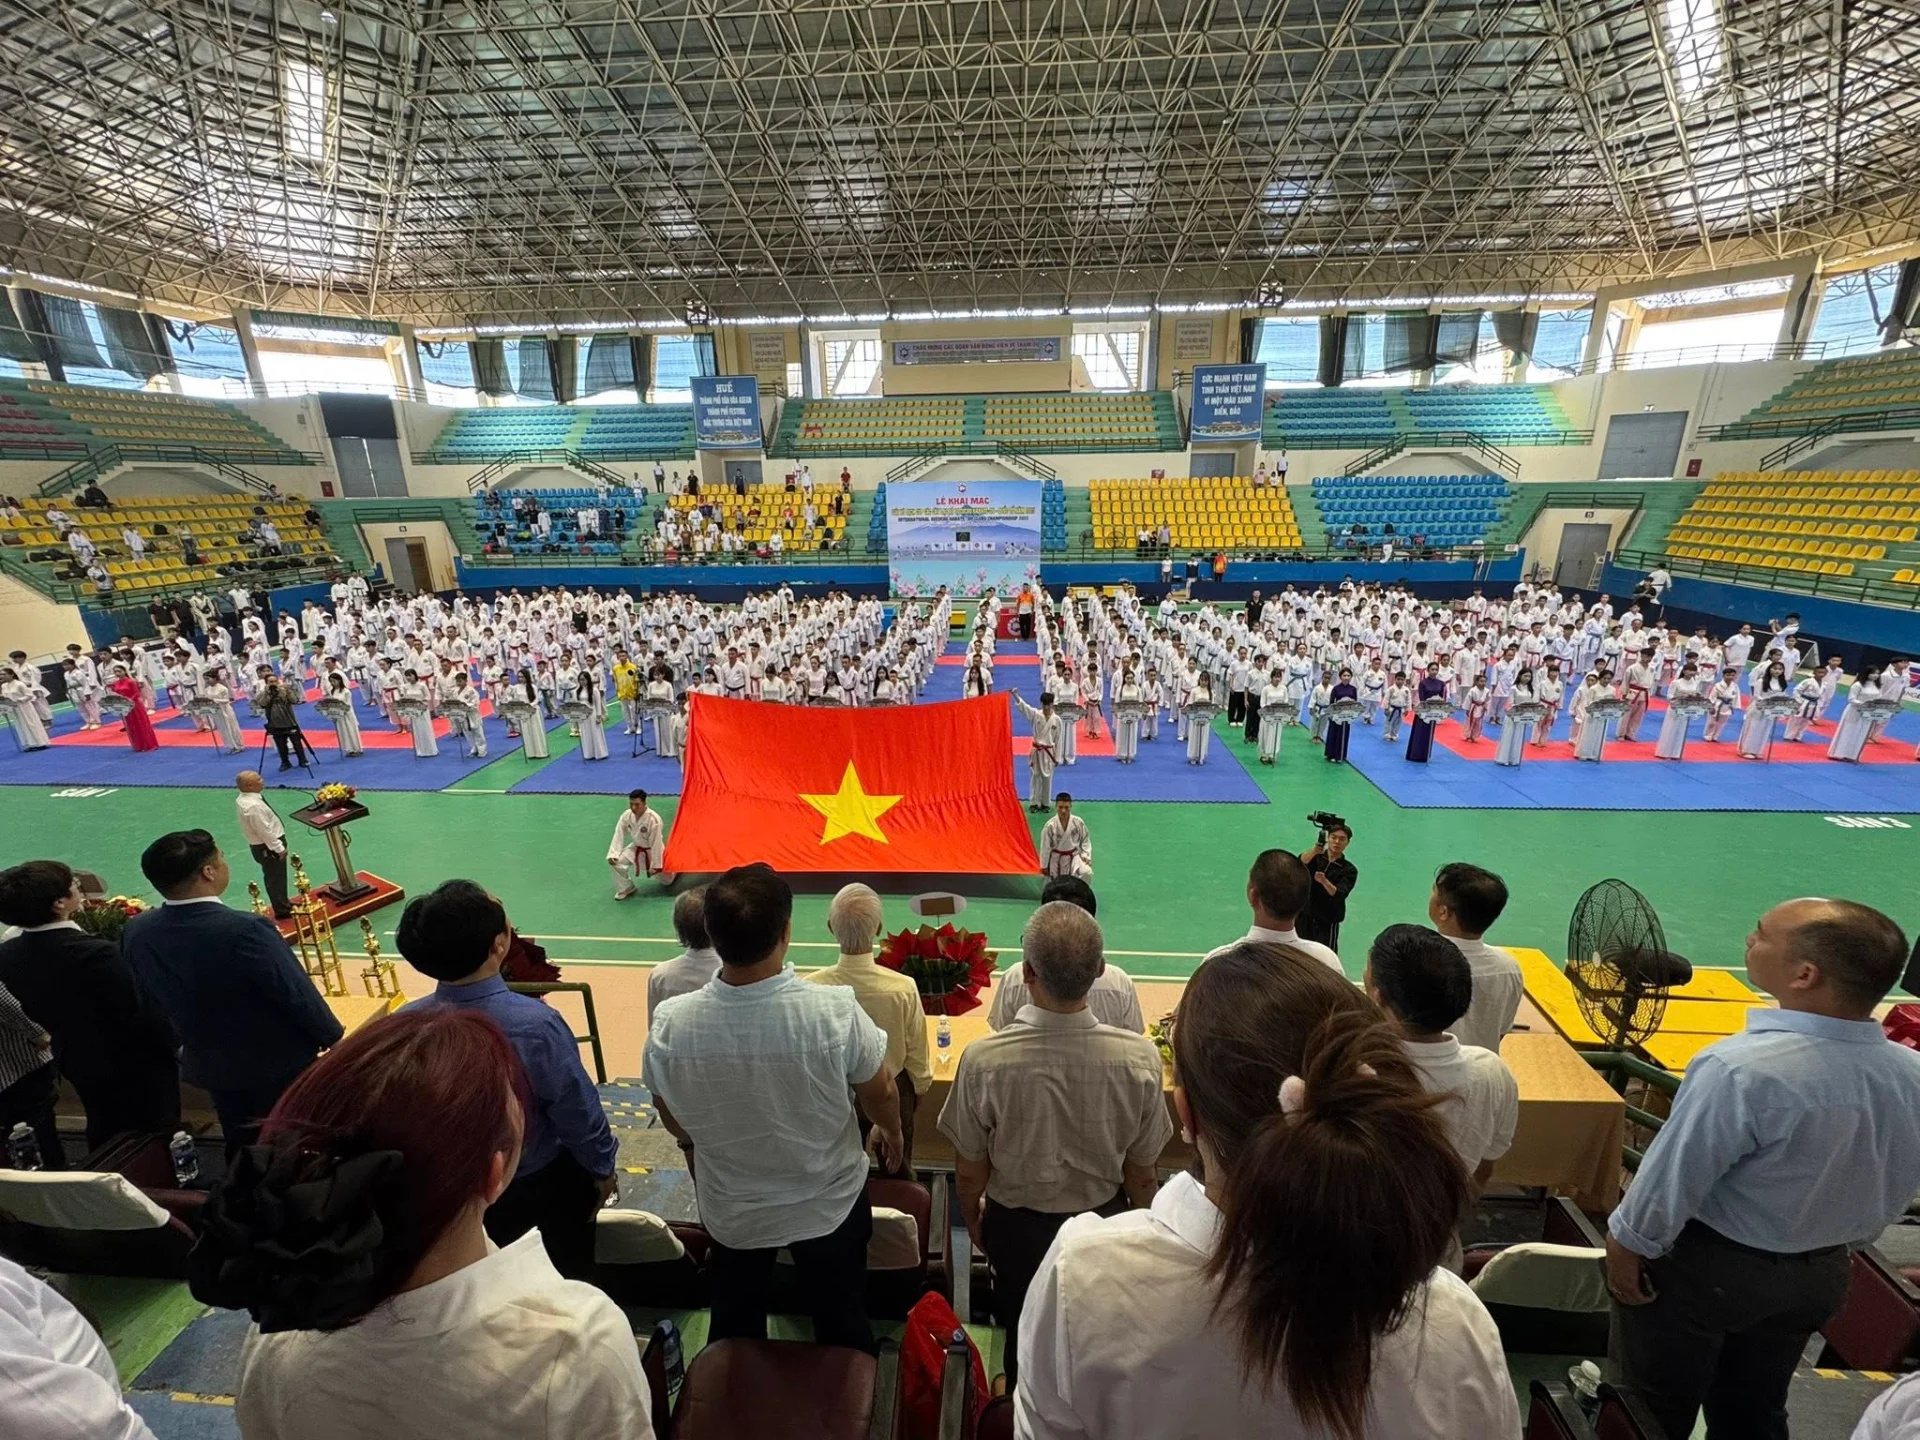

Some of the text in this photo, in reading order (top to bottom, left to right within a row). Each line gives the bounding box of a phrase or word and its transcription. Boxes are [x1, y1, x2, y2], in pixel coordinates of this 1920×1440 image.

[1232, 372, 1243, 384] VIỆT
[1244, 373, 1257, 382] NAM
[1231, 384, 1242, 395] VIỆT
[1243, 384, 1256, 392] NAM
[1237, 396, 1252, 404] XANH
[948, 497, 969, 505] KHAI
